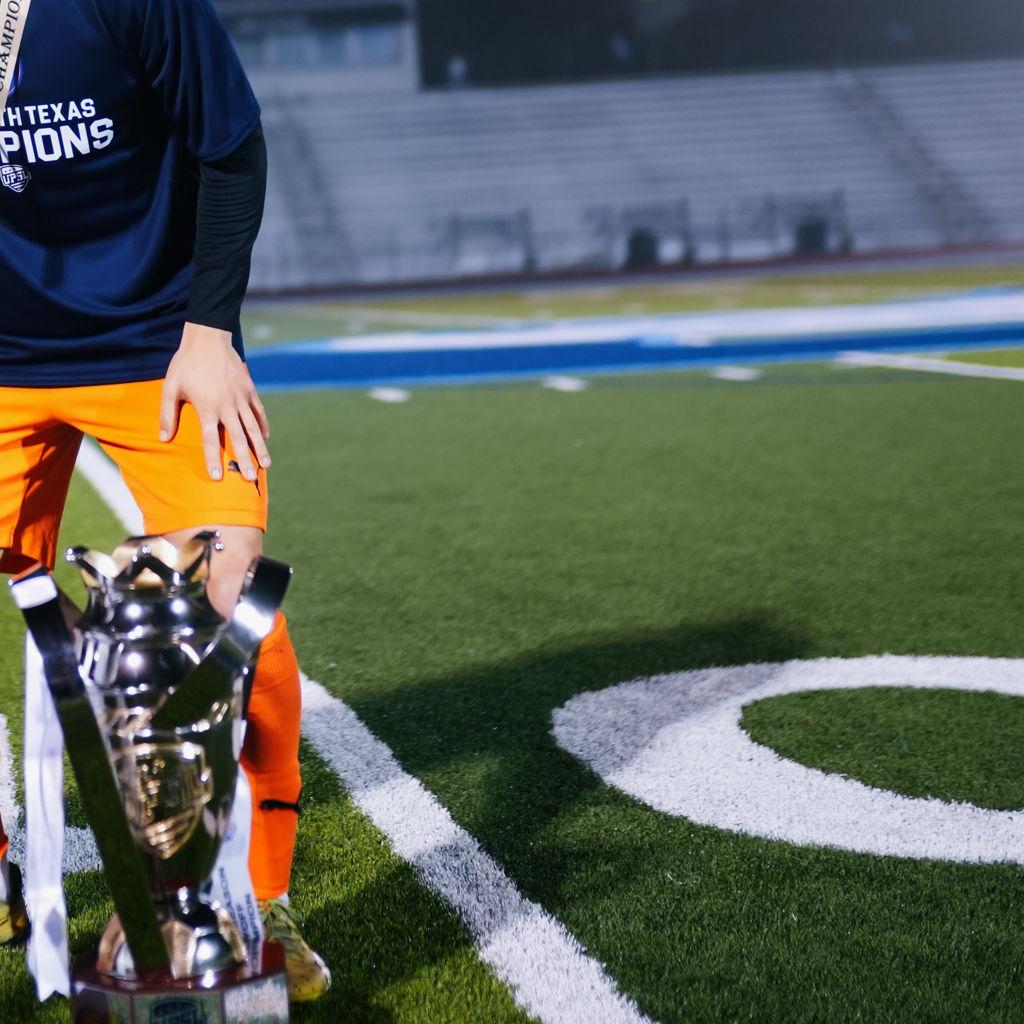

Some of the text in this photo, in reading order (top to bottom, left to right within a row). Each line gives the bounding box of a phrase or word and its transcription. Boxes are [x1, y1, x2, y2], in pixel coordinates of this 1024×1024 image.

[24, 98, 96, 125] TEXAS
[2, 170, 29, 185] UPSL
[218, 866, 238, 921] EASON
